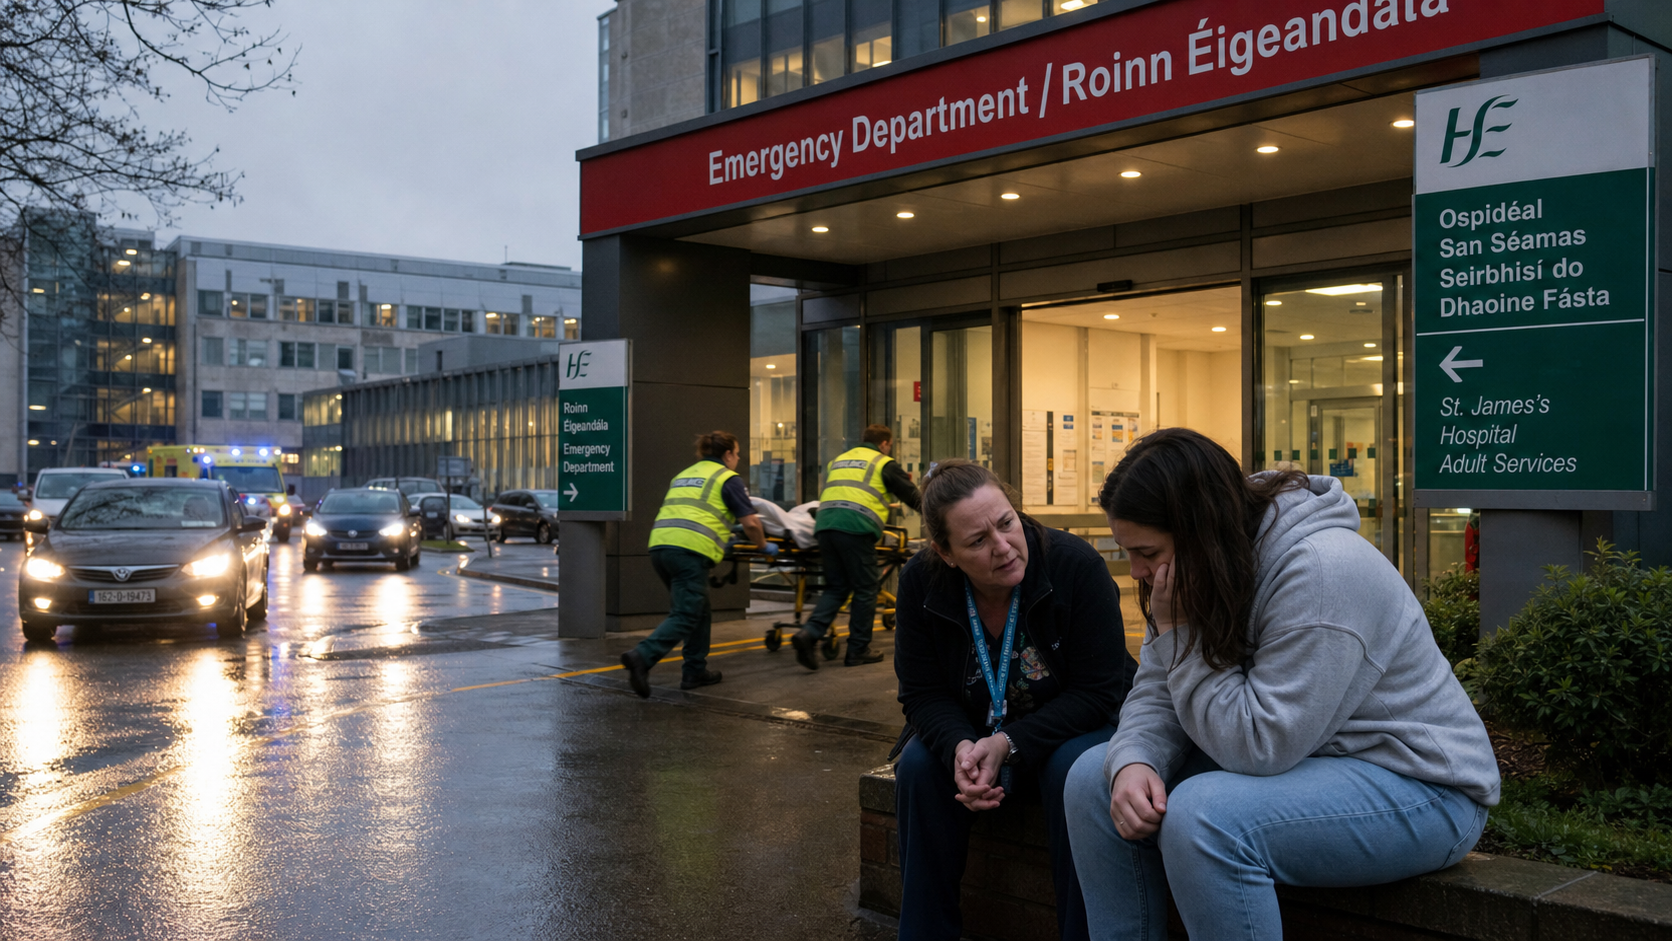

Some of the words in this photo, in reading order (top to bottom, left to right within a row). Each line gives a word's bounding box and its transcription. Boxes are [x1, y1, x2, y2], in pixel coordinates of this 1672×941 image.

[708, 130, 844, 186] Emergency
[852, 76, 1029, 154] Department
[1038, 62, 1053, 119] /
[1062, 50, 1172, 105] Roinn
[1439, 94, 1519, 168] HSE
[1439, 198, 1543, 231] Ospidéal
[1439, 238, 1483, 258] San
[1490, 228, 1587, 253] Séamas
[1439, 259, 1544, 288] Seirbhisí
[1552, 257, 1584, 278] do
[1440, 293, 1535, 318] Dhaoine
[1543, 286, 1610, 310] Fásta
[563, 401, 588, 414] Roinn
[1440, 396, 1464, 417] St.
[563, 443, 611, 457] Emergency
[1440, 424, 1518, 450] Hospital
[563, 461, 615, 476] Department
[1439, 453, 1488, 474] Adult
[1493, 452, 1577, 473] Services
